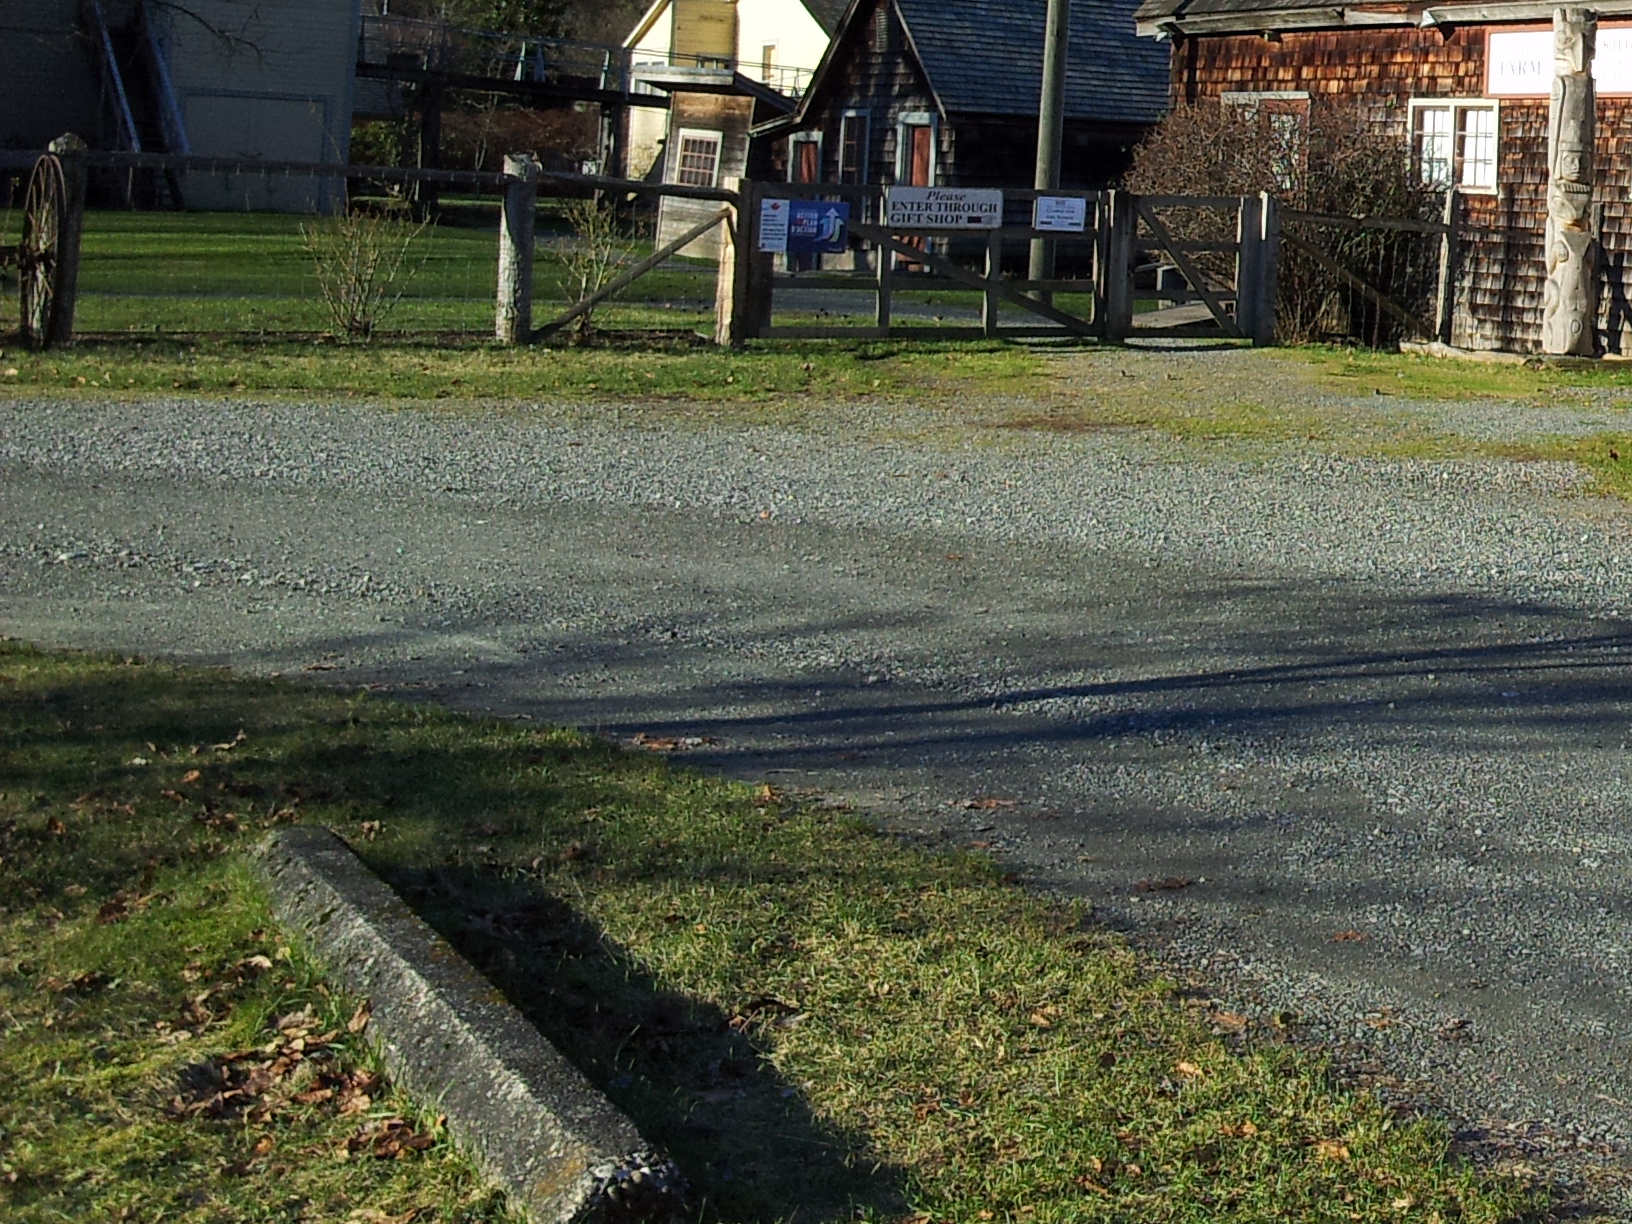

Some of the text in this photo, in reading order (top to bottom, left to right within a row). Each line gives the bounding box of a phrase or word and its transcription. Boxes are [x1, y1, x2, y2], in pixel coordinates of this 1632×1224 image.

[926, 190, 966, 201] Please
[891, 201, 998, 213] ENTER THROUGH
[890, 213, 963, 224] GIFT SHOP
